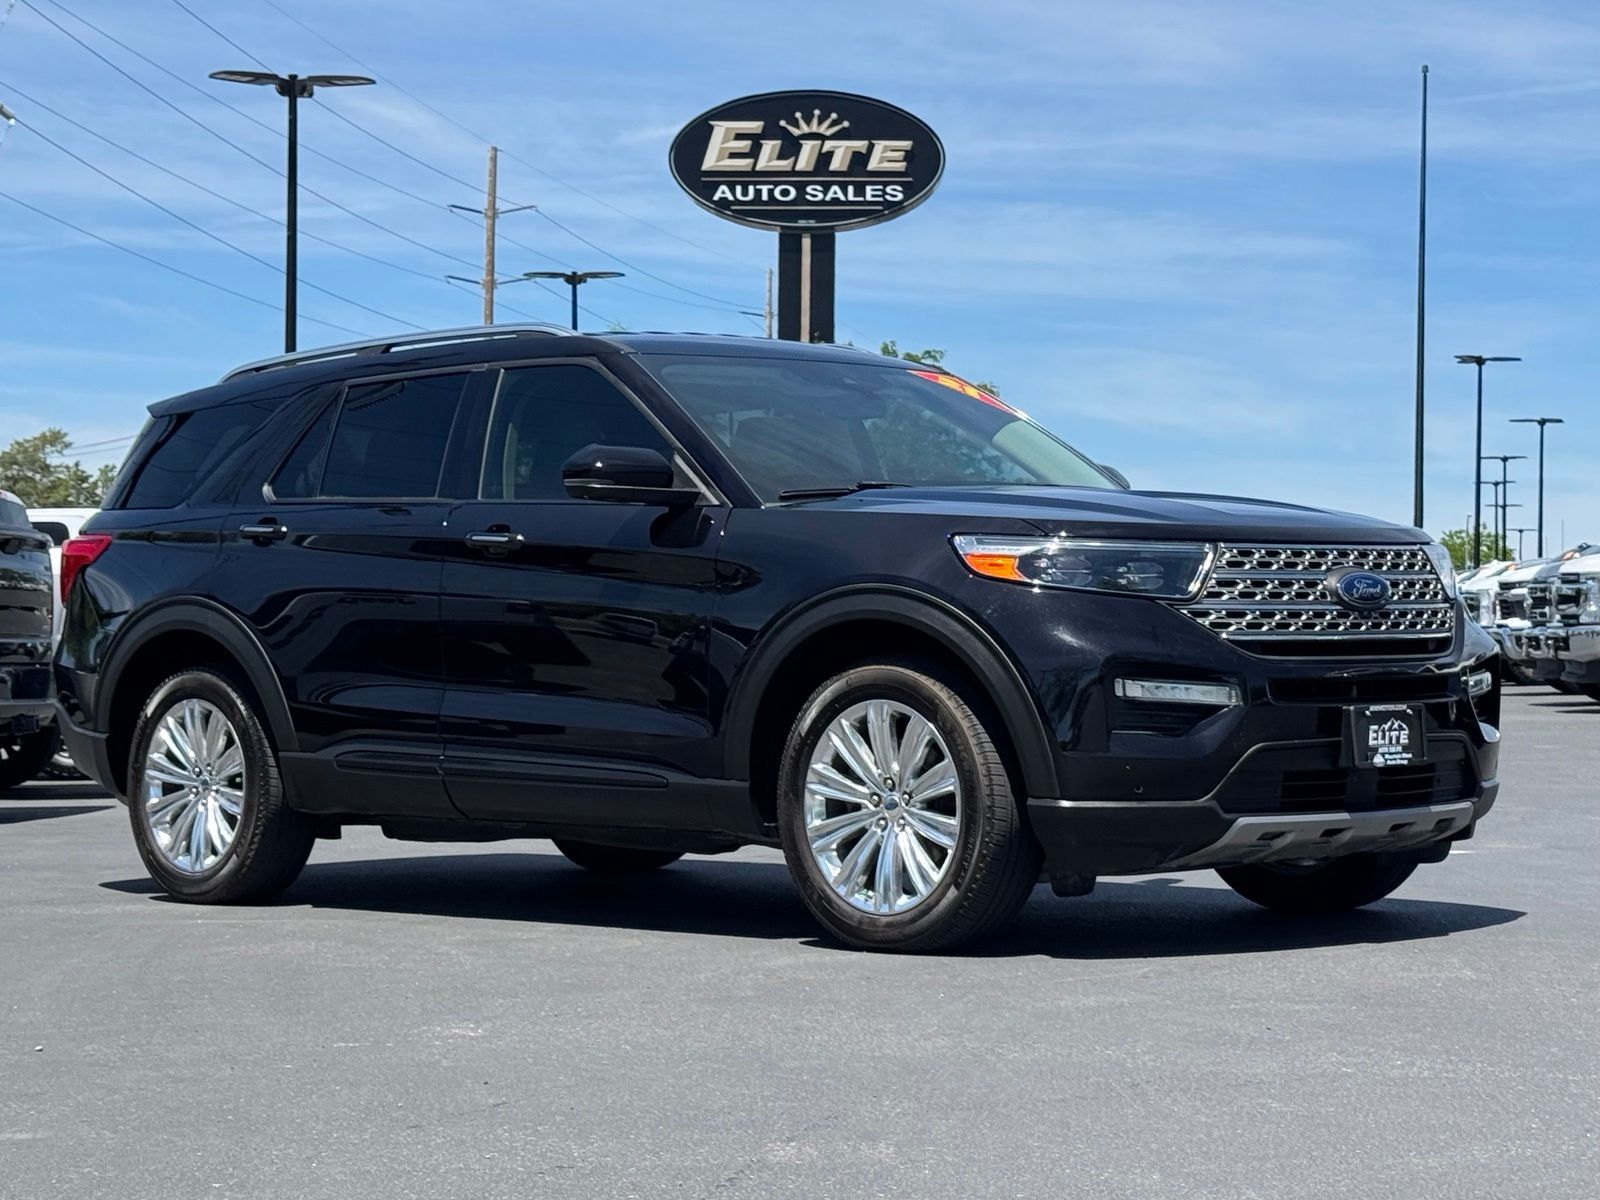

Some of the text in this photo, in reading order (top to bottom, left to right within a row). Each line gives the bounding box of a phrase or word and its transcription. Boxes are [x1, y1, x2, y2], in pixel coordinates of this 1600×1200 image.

[701, 121, 913, 171] ELITE
[712, 185, 904, 201] AUTO SALES
[1353, 578, 1381, 598] Ford
[1368, 725, 1409, 746] ELITE
